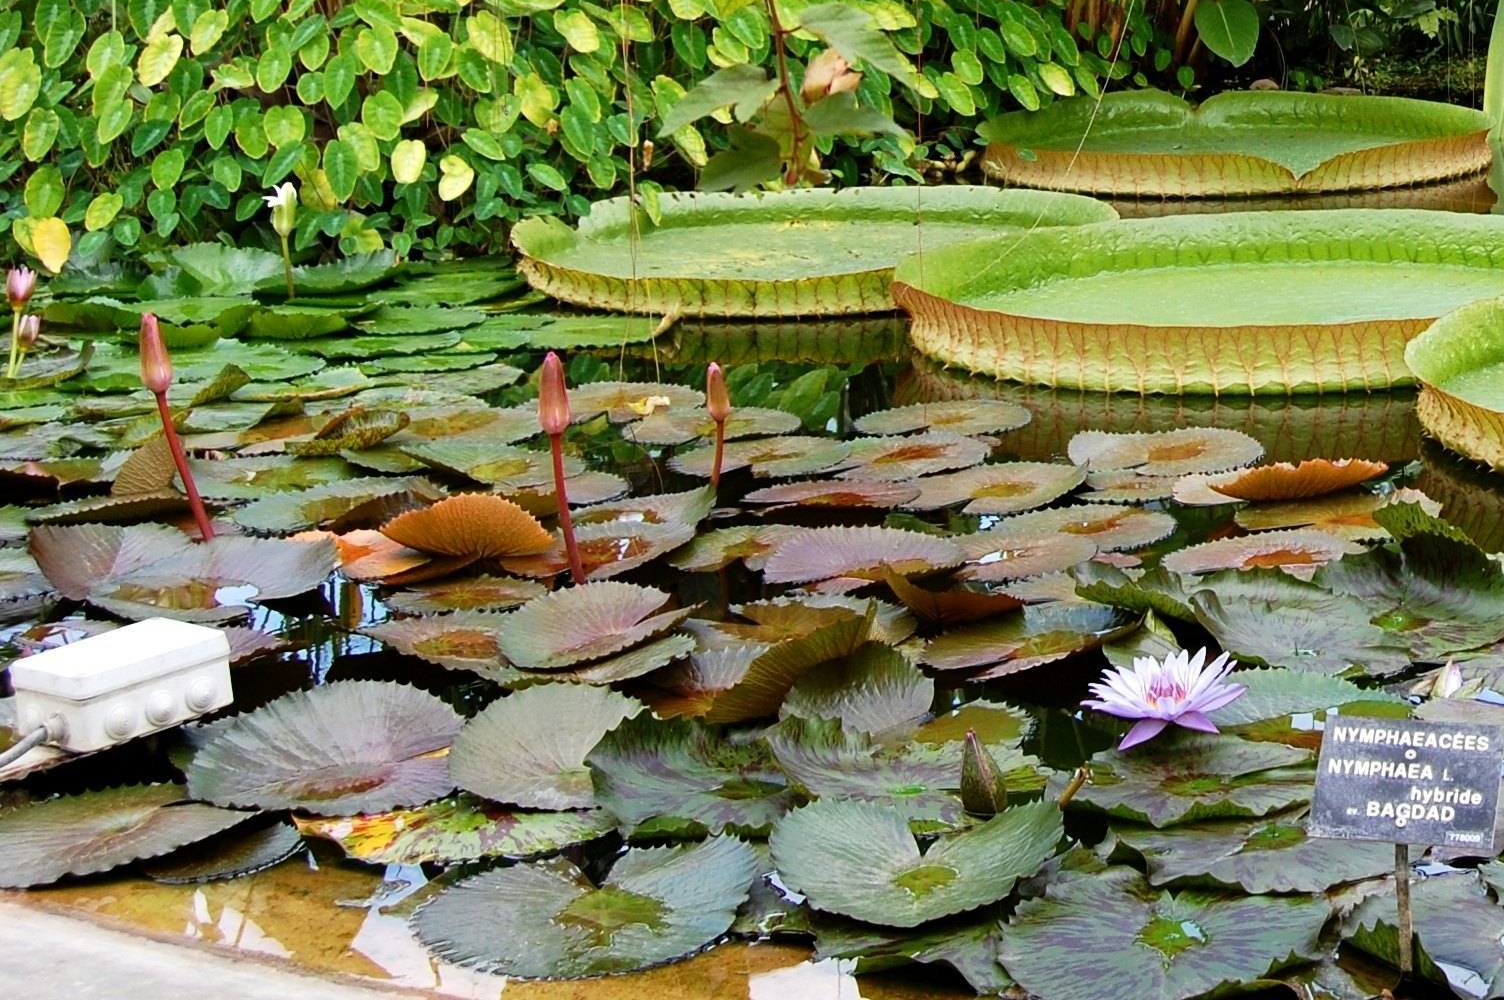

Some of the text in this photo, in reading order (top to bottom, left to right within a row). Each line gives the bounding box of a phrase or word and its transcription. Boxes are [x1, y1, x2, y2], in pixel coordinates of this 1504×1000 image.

[1333, 726, 1490, 751] NYMPHAEACÉES
[1328, 758, 1433, 780] NYMPHAEA
[1410, 785, 1483, 806] hybride
[1366, 801, 1456, 822] BAGDAD
